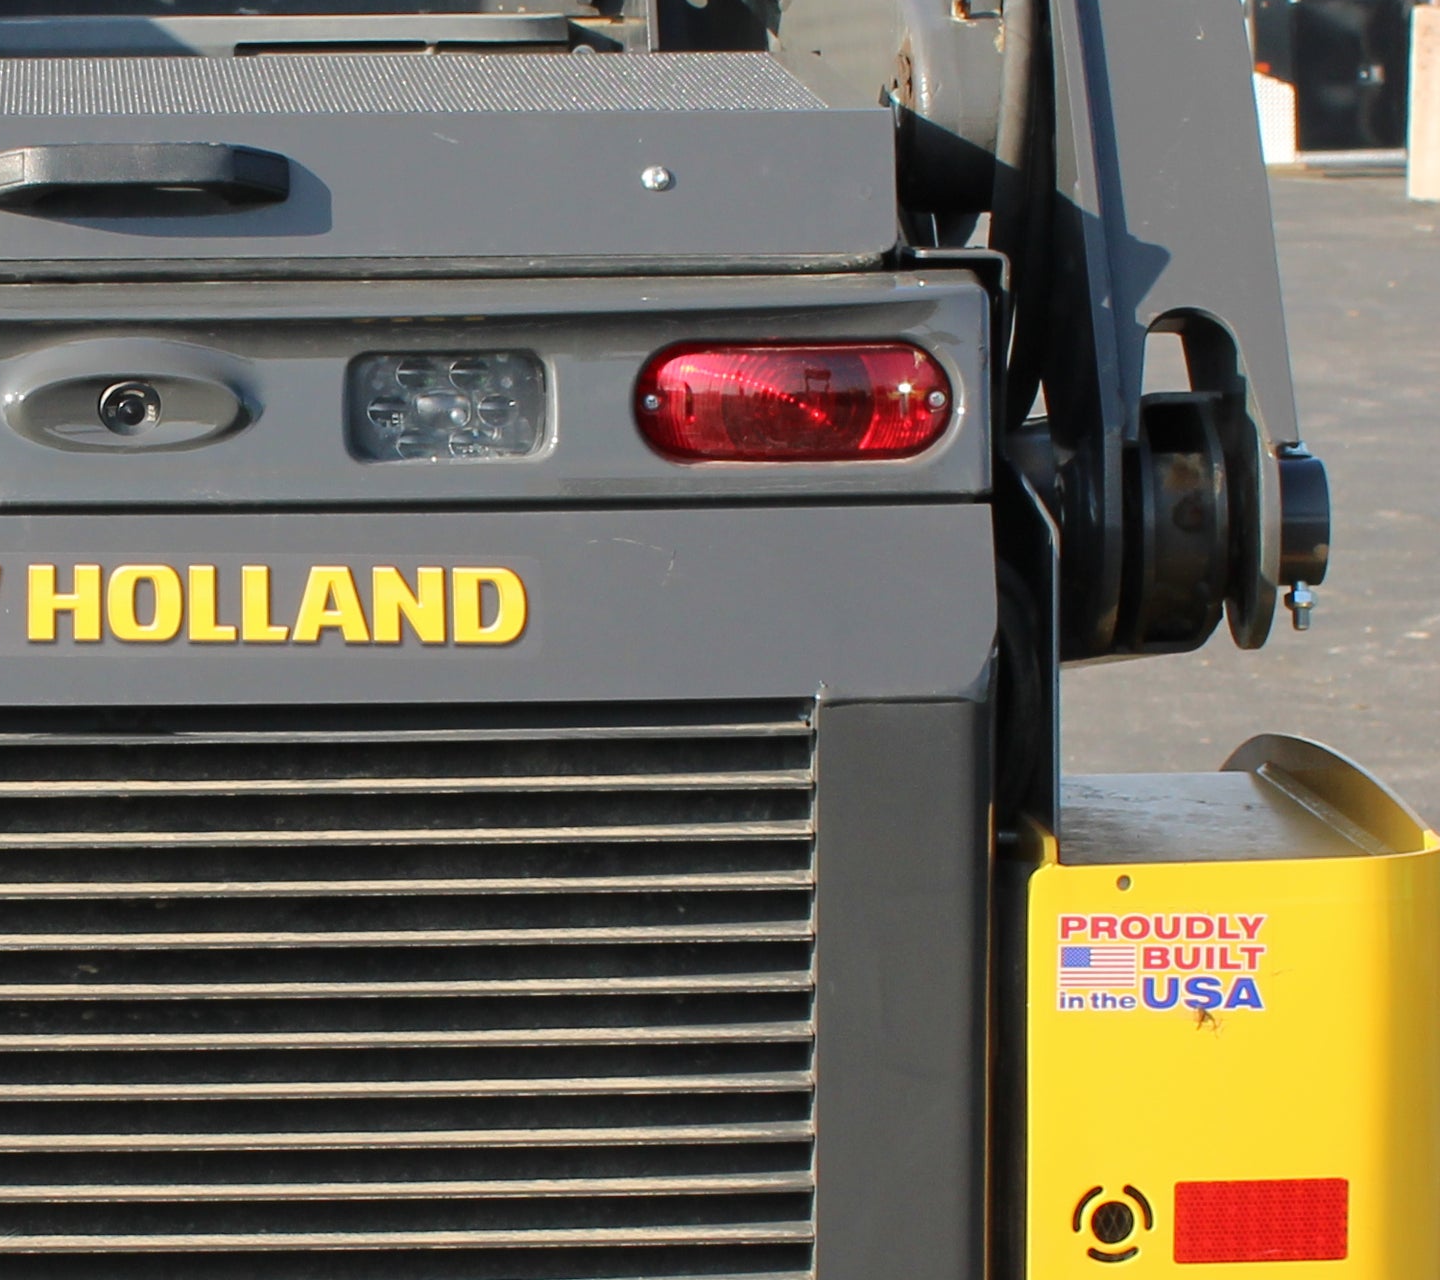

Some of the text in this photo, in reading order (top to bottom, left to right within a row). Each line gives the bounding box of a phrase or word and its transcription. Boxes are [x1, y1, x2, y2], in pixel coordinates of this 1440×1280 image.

[26, 564, 528, 646] HOLLAND
[1060, 916, 1265, 940] PROUDLY
[1142, 947, 1265, 970] BUILT
[1059, 976, 1264, 1010] in the USA
